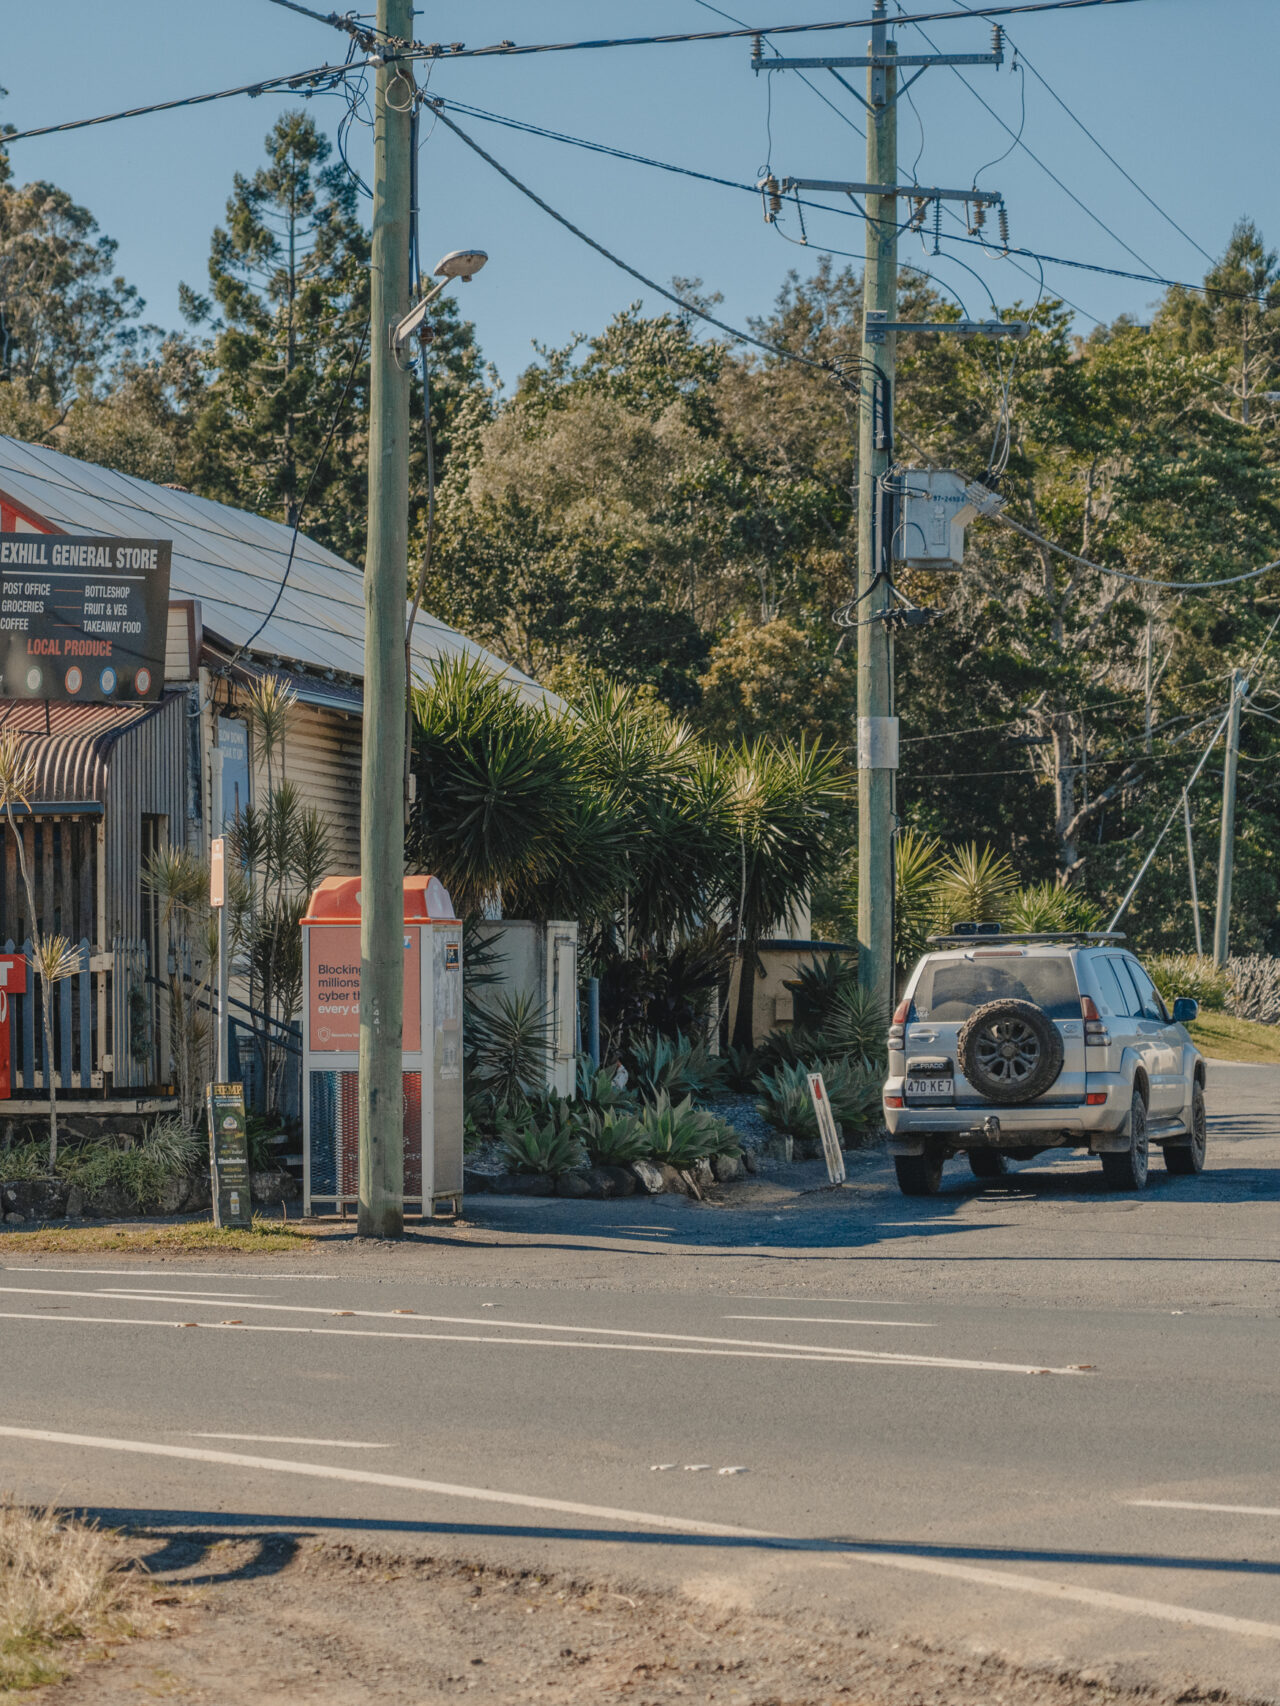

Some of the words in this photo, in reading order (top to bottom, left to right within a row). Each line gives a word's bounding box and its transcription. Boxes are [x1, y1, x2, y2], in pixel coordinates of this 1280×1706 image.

[52, 544, 113, 568] GENERAL
[115, 547, 158, 570] STORE
[3, 582, 23, 595] POST
[24, 583, 51, 596] OFFICE
[84, 585, 131, 599] BOTTLESHOP
[1, 600, 44, 614] GROCERIES
[84, 603, 105, 616] FRUIT
[106, 603, 112, 616] &
[113, 603, 128, 617] VEG
[0, 618, 29, 631] COFFEE
[83, 620, 121, 633] TAKEAWAY
[122, 621, 141, 634] FOOD
[27, 638, 61, 656] LOCAL
[64, 639, 113, 657] PRODUCE
[318, 964, 361, 976] Blockin
[318, 977, 360, 988] millions
[318, 990, 350, 1003] cyber
[317, 1005, 350, 1016] every
